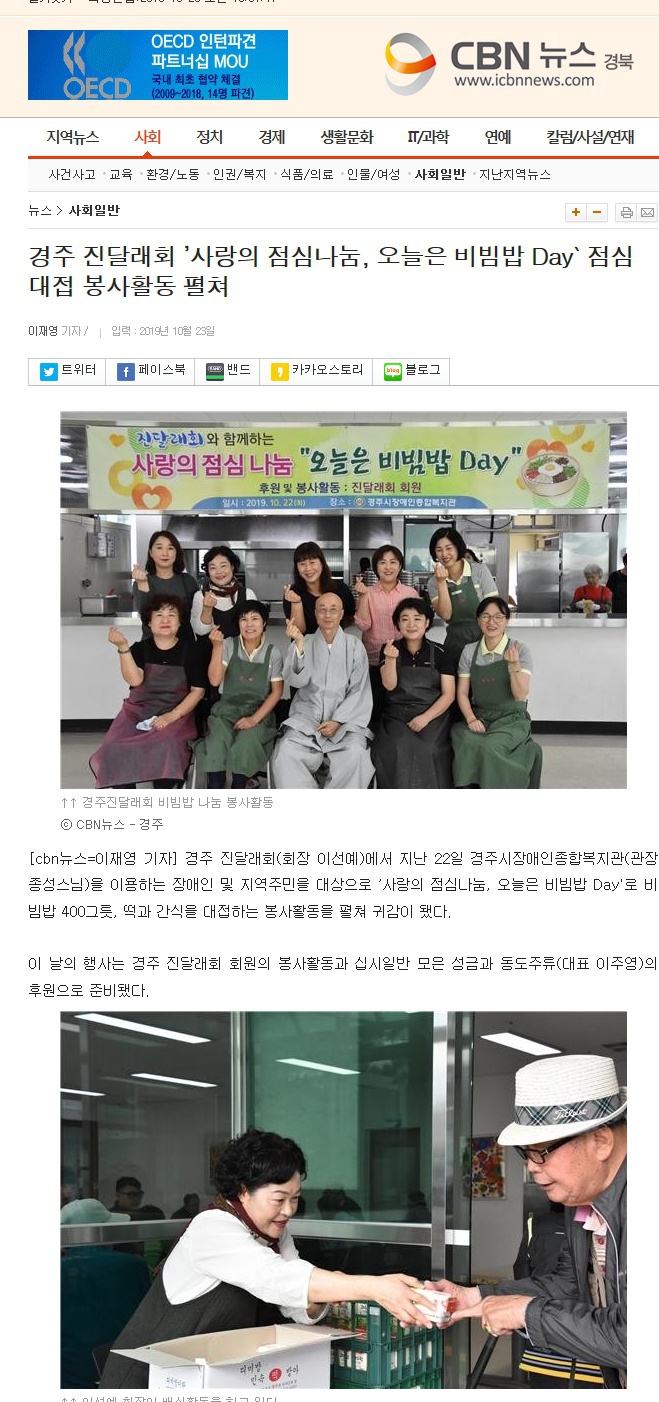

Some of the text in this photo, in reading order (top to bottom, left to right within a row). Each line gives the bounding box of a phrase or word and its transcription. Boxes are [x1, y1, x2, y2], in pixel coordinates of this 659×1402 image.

[151, 33, 257, 50] OECD 인턴파견
[151, 53, 249, 70] 파트너십 MOU
[451, 41, 634, 71] CBN 뉴스 경북
[151, 74, 241, 86] 국내 최초 협약 체결
[454, 73, 595, 88] www.icbnnews.com
[63, 77, 132, 100] OECD
[151, 88, 255, 100] (2009~2018, 14명 파견)
[47, 130, 634, 145] 지역뉴스 사회 정치 경제 생활문화 IT/과학 연예 칼럼/사설/연재
[49, 169, 550, 180] 사건사고 교육 환경/노동 인권/복지 식품/의료 인물/여성 사회일반 지난지역뉴스
[29, 205, 120, 216] 뉴스 사회일반
[30, 246, 75, 267] 경주
[84, 246, 173, 267] 진달래회
[268, 245, 368, 268] 점심나눔,
[378, 246, 447, 266] 오늘은
[455, 245, 525, 267] 비빔밥
[588, 246, 631, 267] 점심
[30, 275, 228, 297] 대접 봉사활동 펼쳐
[29, 326, 214, 336] 이재영 기자 입력 2019년 10월 23일
[62, 364, 95, 375] 트위터
[139, 364, 185, 375] 페이스북
[228, 364, 250, 375] 밴드
[293, 364, 362, 375] 카카오스토리
[406, 364, 440, 375] 블로그
[224, 432, 274, 446] 함께하는
[131, 452, 293, 477] 사랑의 점심 나눔
[300, 446, 522, 476] "오늘은 비빔밥 Day"
[259, 481, 422, 495] 후원 및 봉사활동 진달래회 회원
[222, 498, 239, 508] 일시
[246, 498, 268, 508] 2019.
[329, 498, 347, 508] 장소
[83, 797, 273, 808] 경주진달래회 비빔밥 나눔 봉사활동
[77, 819, 163, 830] CBN뉴스 경주
[29, 984, 148, 997] 후원으로 준비됐다.
